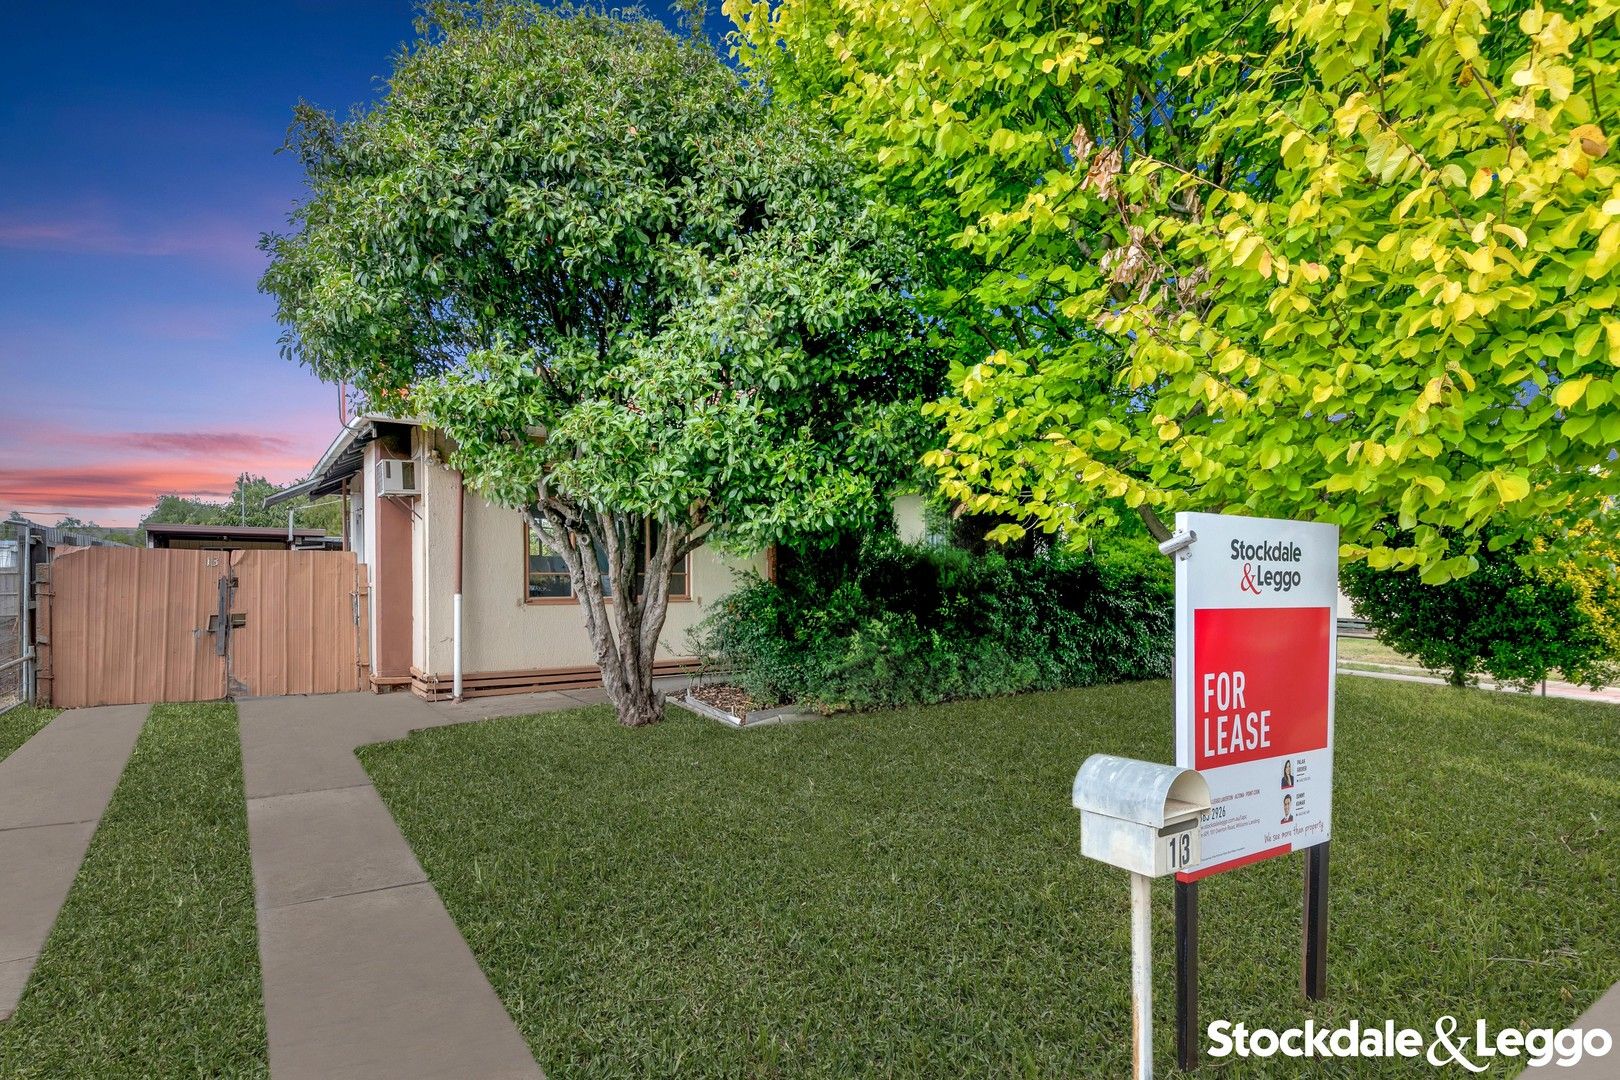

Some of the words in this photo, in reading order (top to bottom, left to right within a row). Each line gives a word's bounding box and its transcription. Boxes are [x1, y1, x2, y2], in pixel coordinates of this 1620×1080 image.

[1230, 538, 1302, 563] Stockdale
[1203, 671, 1246, 713] FOR
[1203, 710, 1272, 758] LEASE
[1211, 805, 1226, 820] 2926
[1272, 833, 1281, 841] see
[1281, 830, 1292, 839] more
[1292, 823, 1304, 835] than
[1169, 833, 1190, 868] 13
